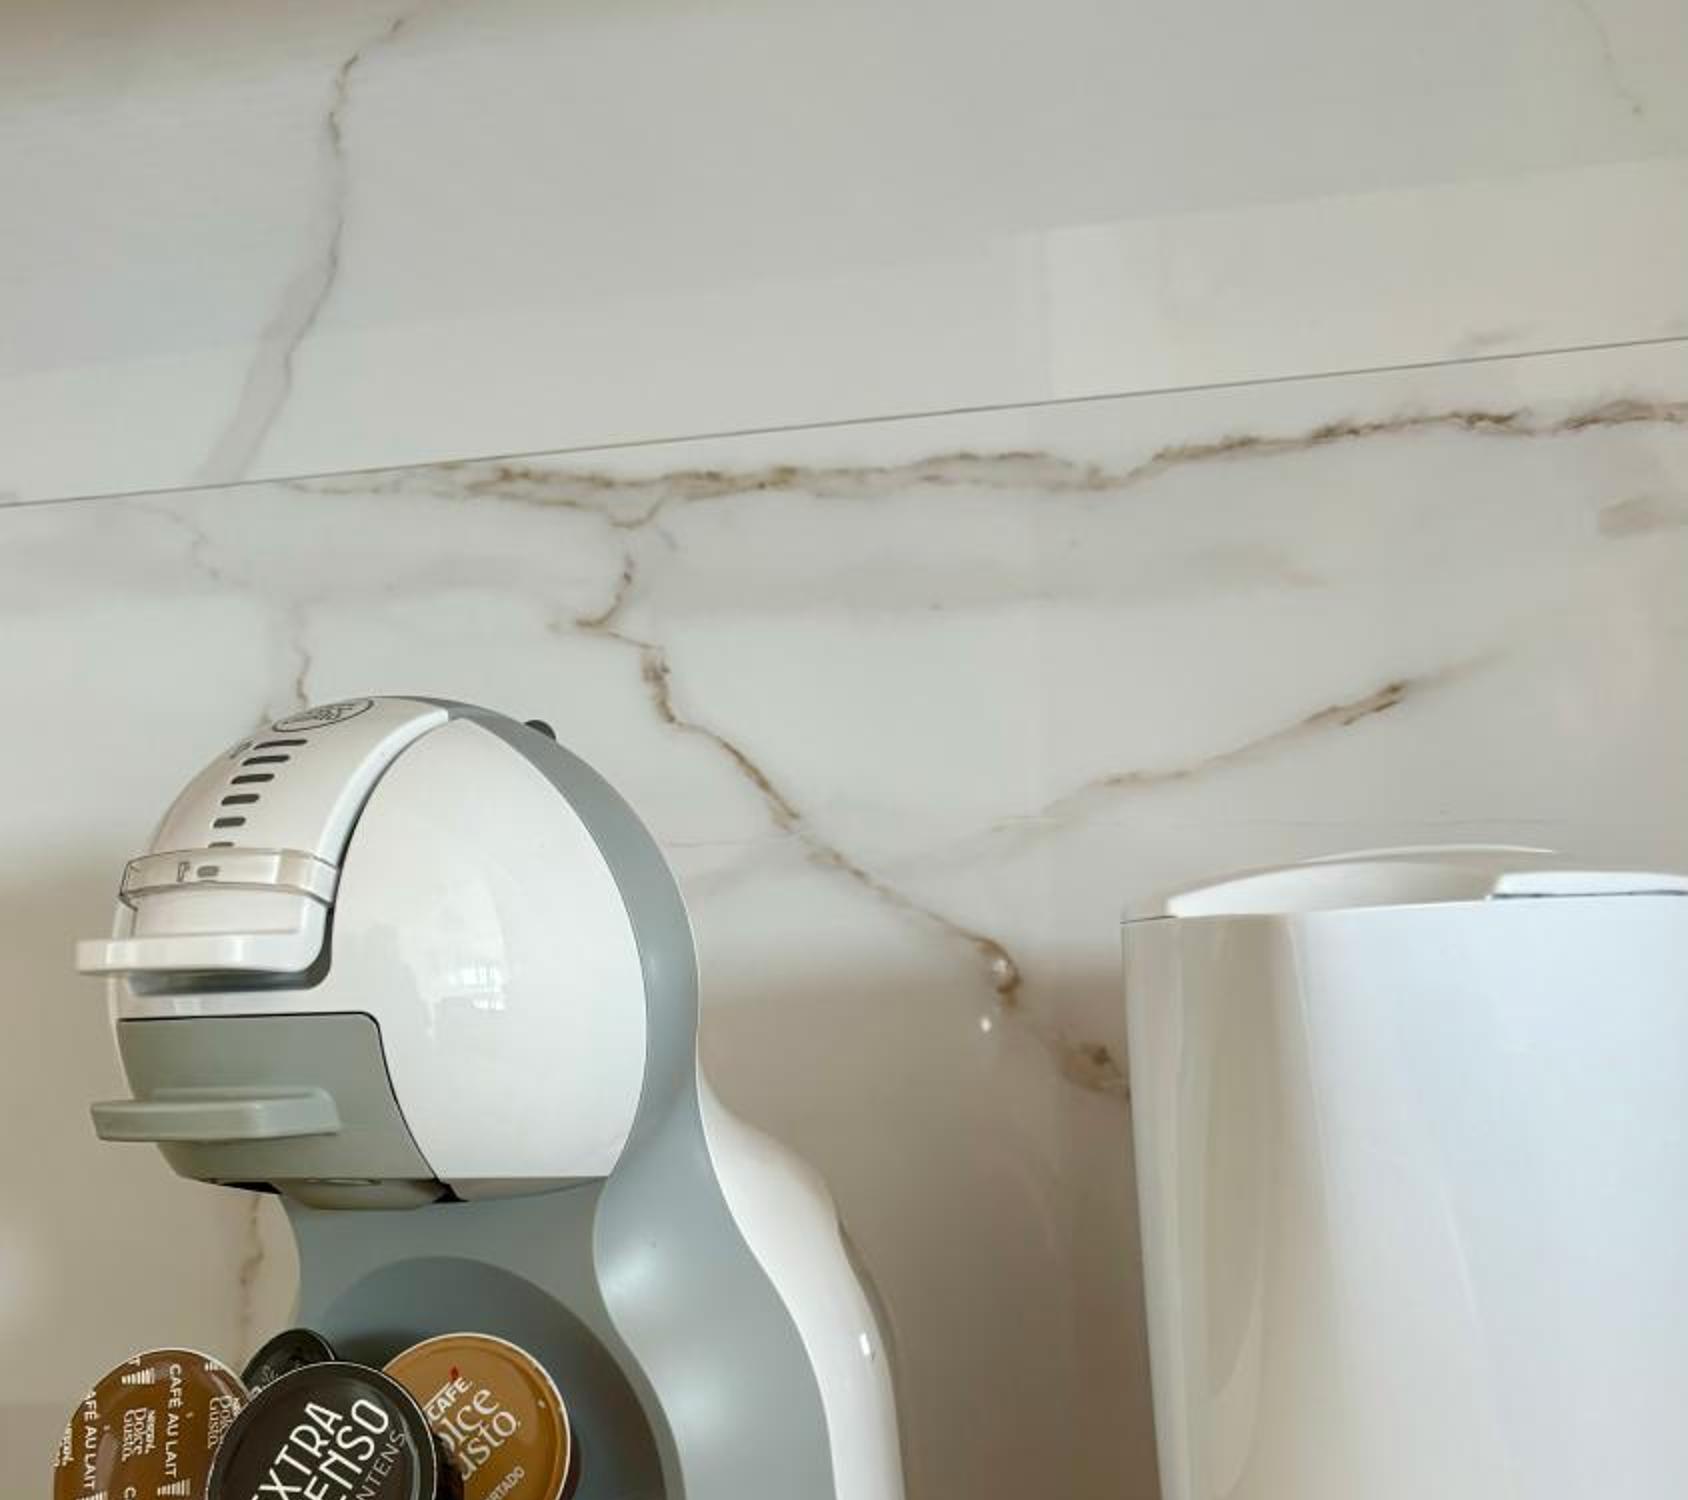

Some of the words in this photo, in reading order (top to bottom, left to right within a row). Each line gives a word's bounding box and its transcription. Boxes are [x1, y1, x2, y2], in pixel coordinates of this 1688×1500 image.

[167, 1363, 184, 1410] CAFÉ
[84, 1425, 97, 1450] AU
[167, 1413, 180, 1437] AU
[83, 1453, 98, 1490] LAIT
[164, 1441, 178, 1479] LAIT
